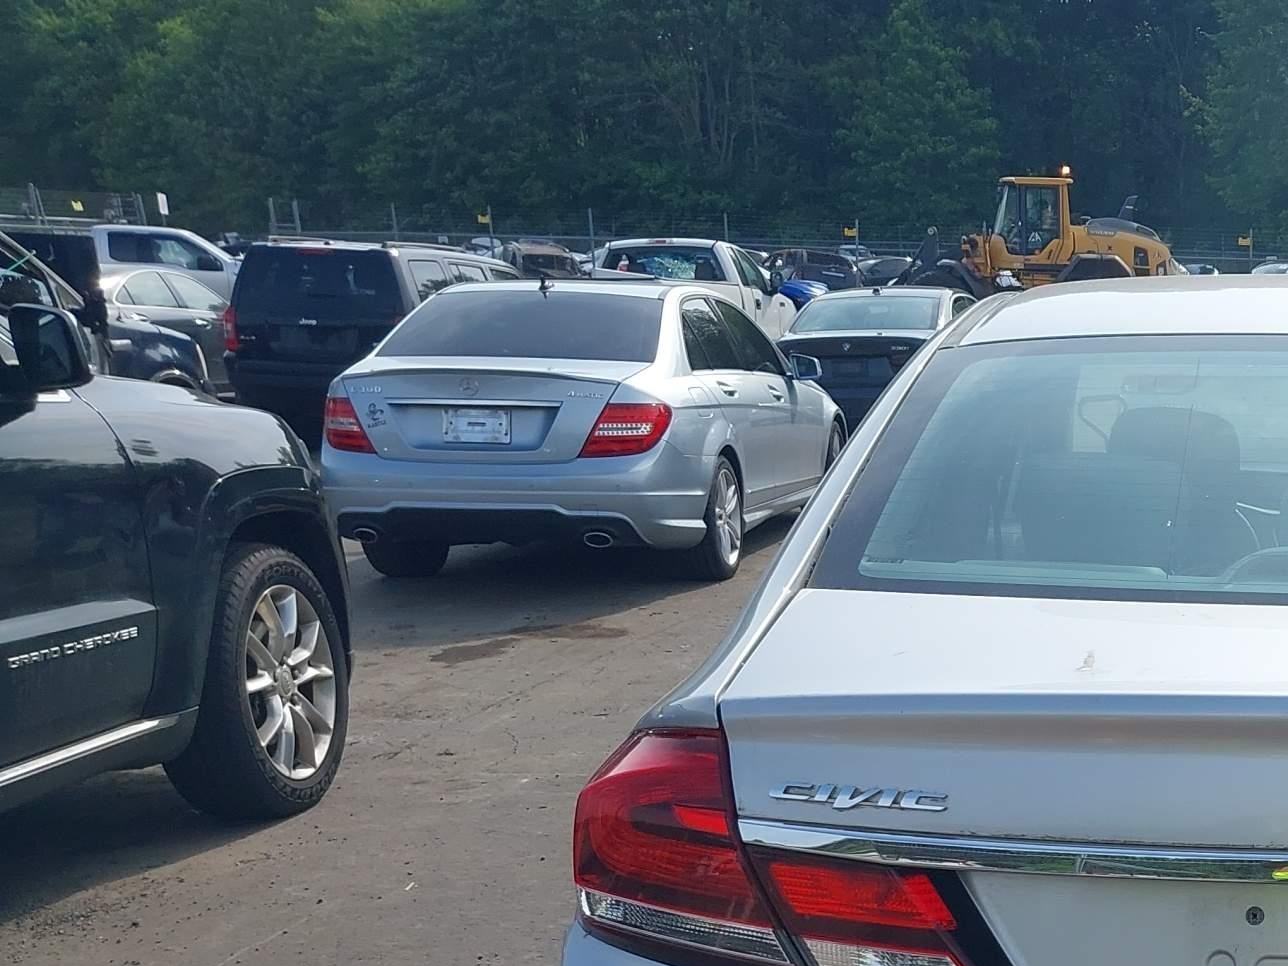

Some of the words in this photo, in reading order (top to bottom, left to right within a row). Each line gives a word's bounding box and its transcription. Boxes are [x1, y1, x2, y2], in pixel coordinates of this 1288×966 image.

[8, 646, 60, 668] GRAND
[63, 626, 139, 655] CHEROKEE
[769, 783, 948, 812] CIVIC
